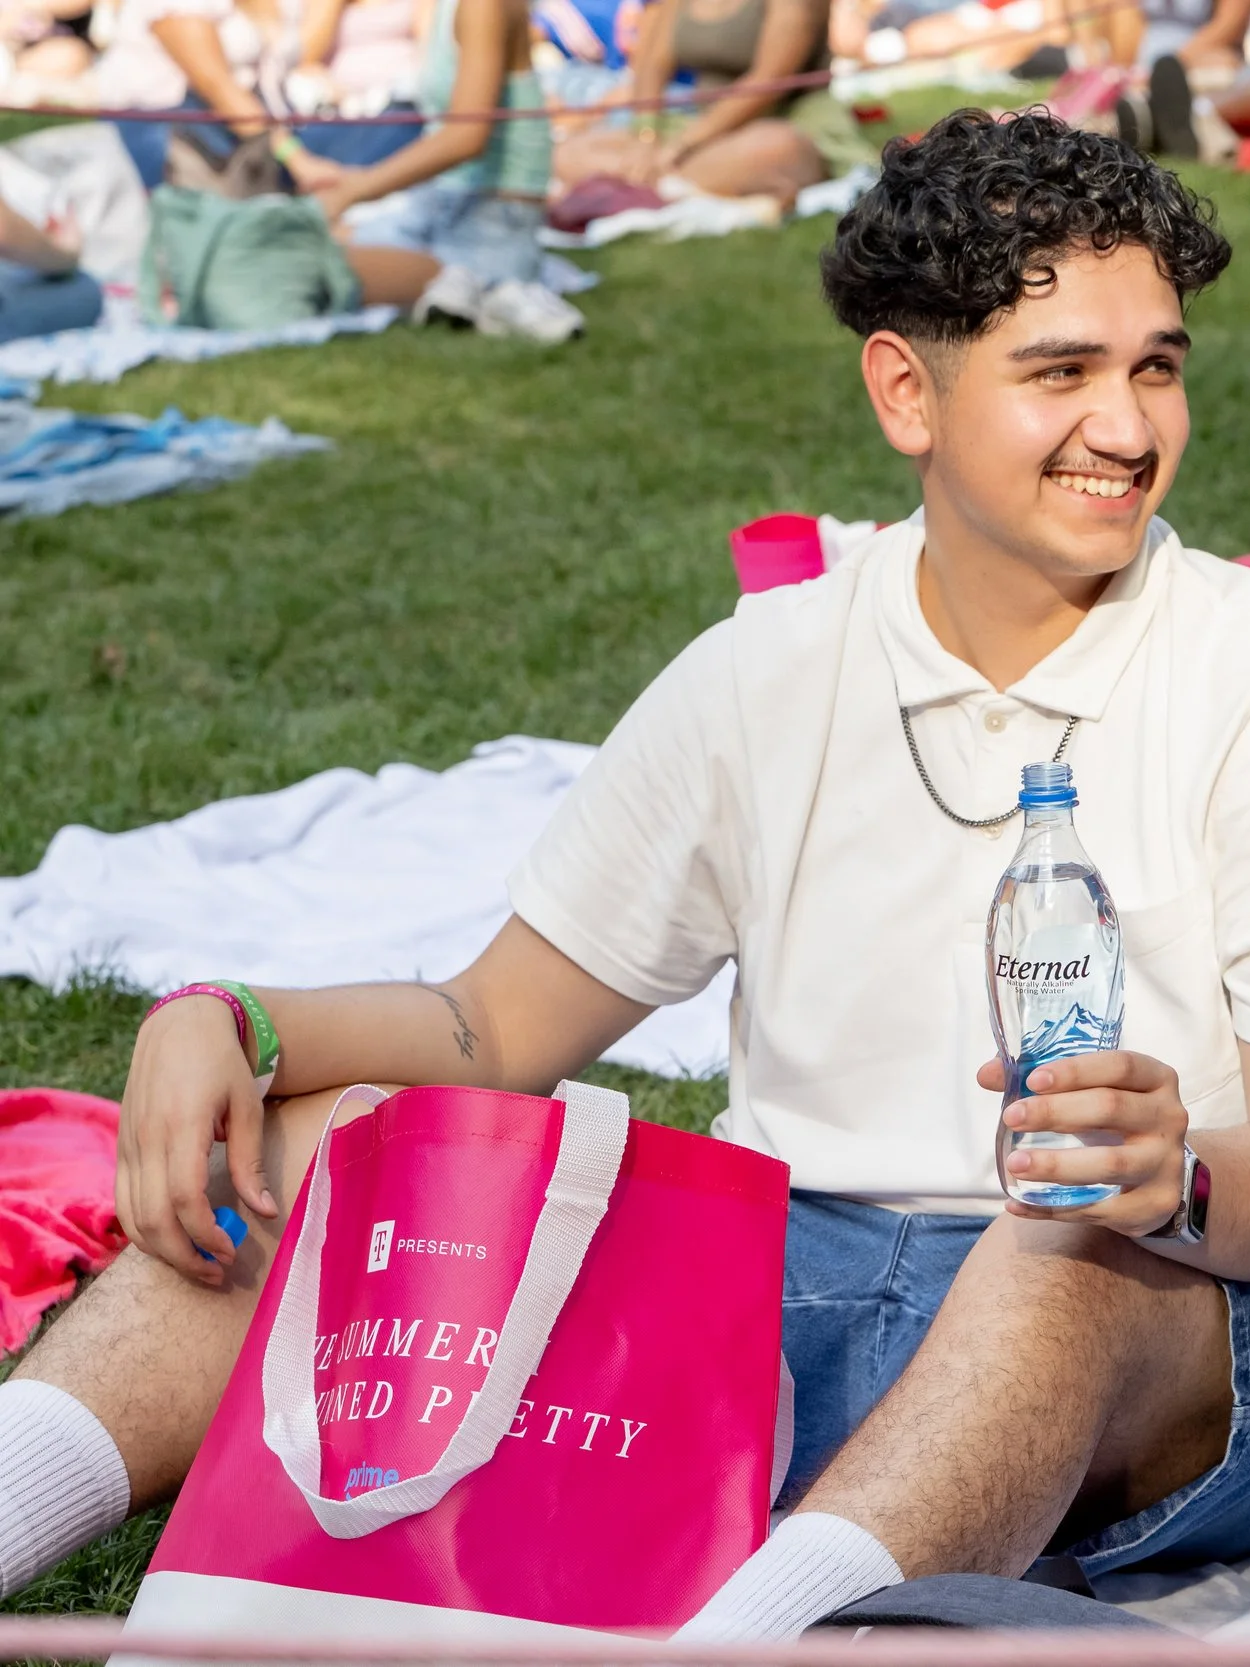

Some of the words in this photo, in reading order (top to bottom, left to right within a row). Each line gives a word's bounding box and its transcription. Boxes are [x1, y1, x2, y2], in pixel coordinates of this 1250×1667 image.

[996, 954, 1090, 980] Eternal
[1006, 979, 1039, 988] Naturally
[1015, 987, 1038, 995] Spring
[1040, 987, 1066, 995] Water
[397, 1239, 487, 1260] PRESENTS
[337, 1318, 499, 1367] SUMMER
[316, 1381, 394, 1426] URNED
[344, 1461, 399, 1491] prime
